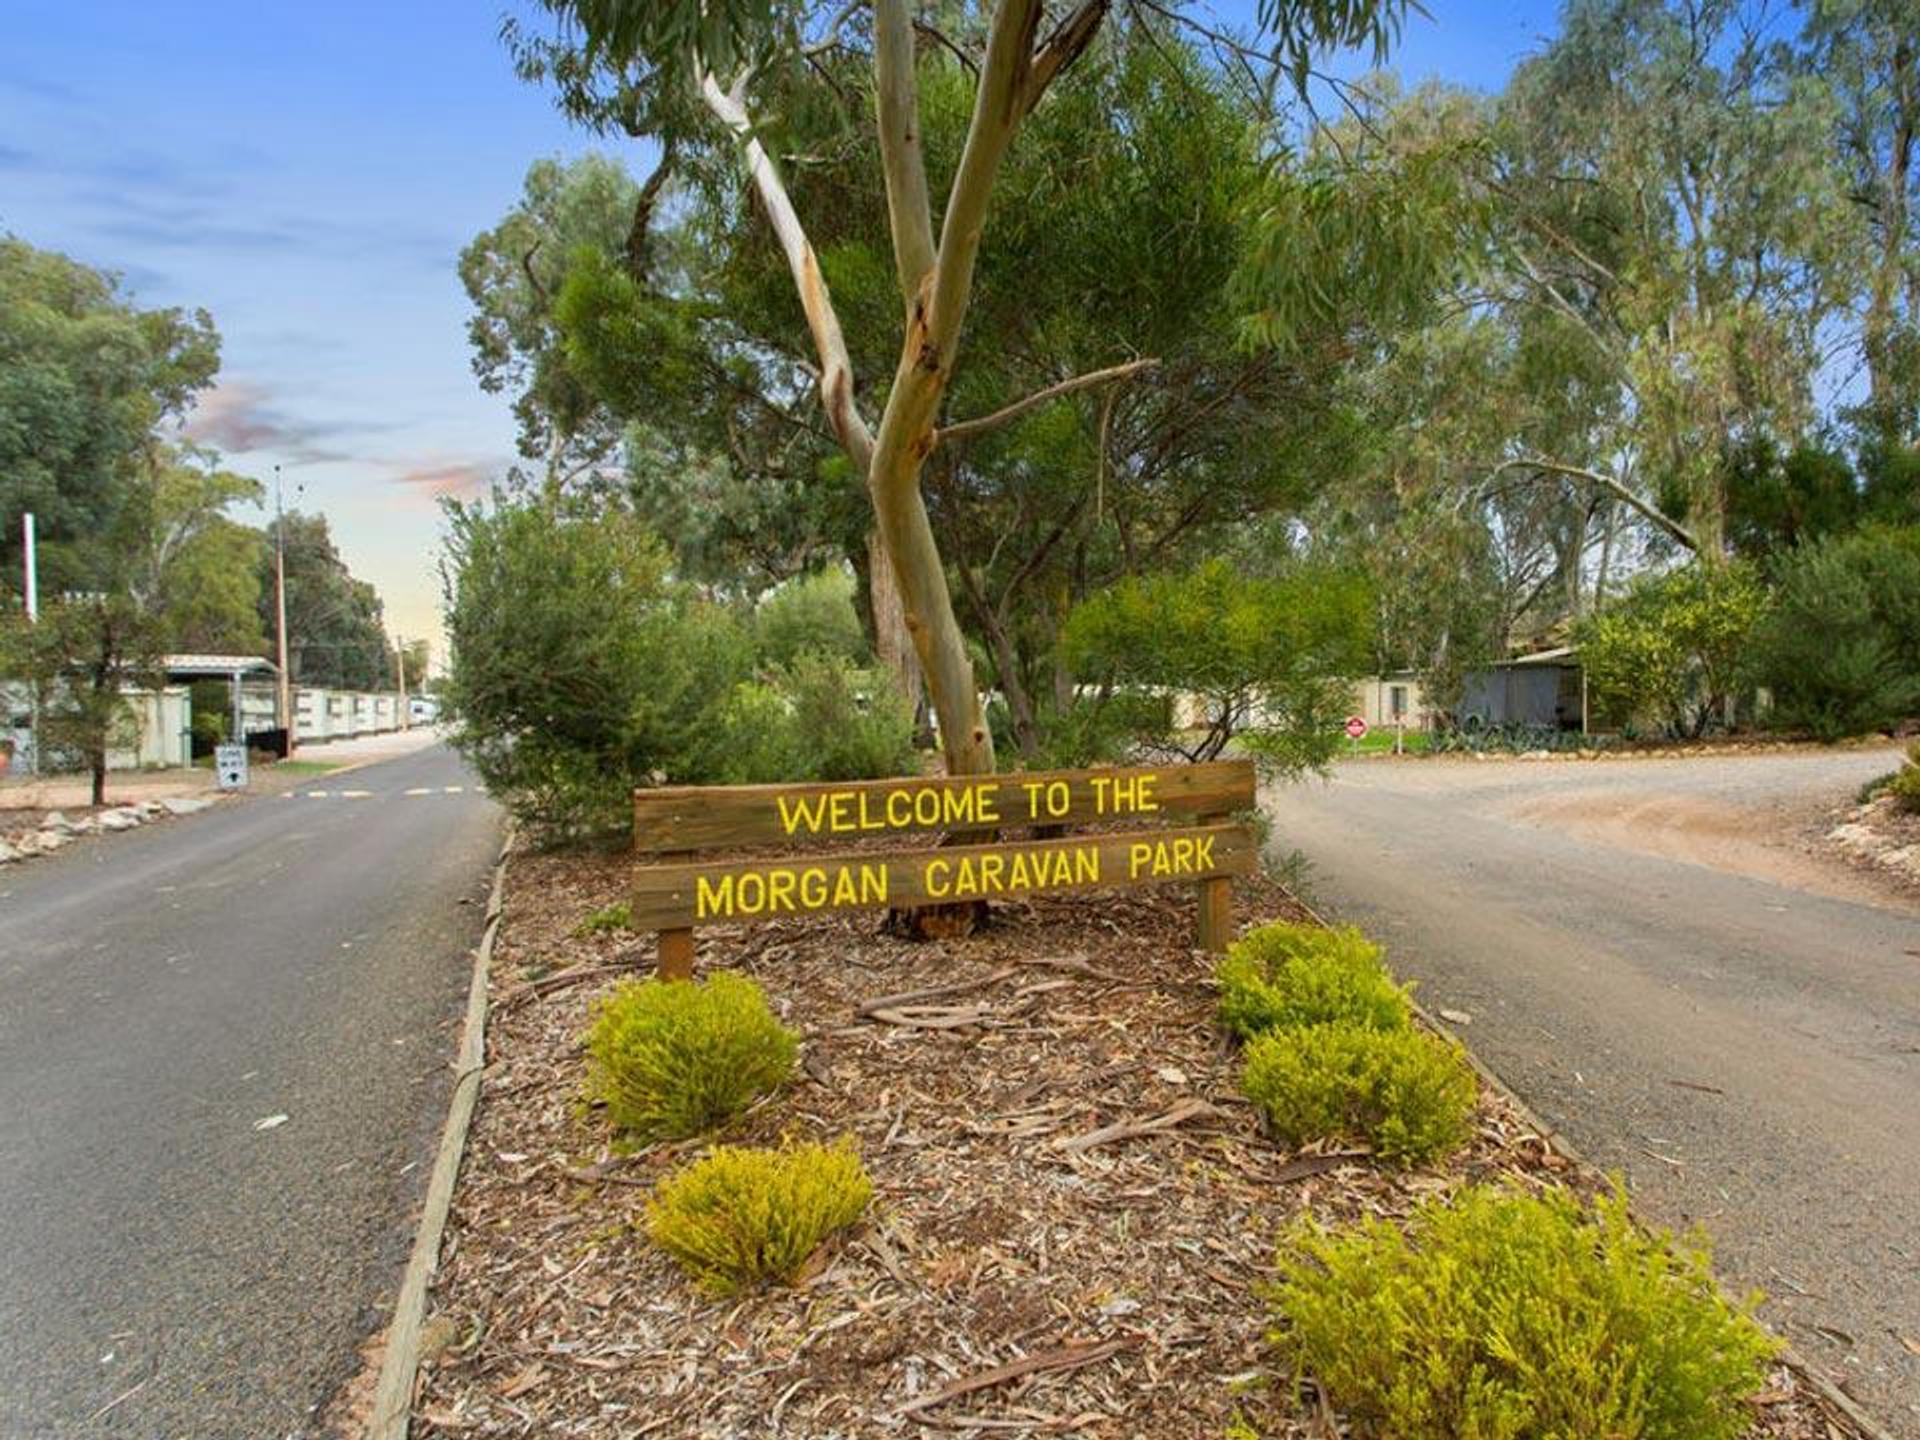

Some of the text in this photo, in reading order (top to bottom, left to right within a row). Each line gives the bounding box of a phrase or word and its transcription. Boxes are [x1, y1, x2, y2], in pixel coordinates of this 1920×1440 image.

[778, 774, 1158, 835] WELCOME TO THE
[696, 837, 1215, 918] MORGAN CARAVAN PARK
